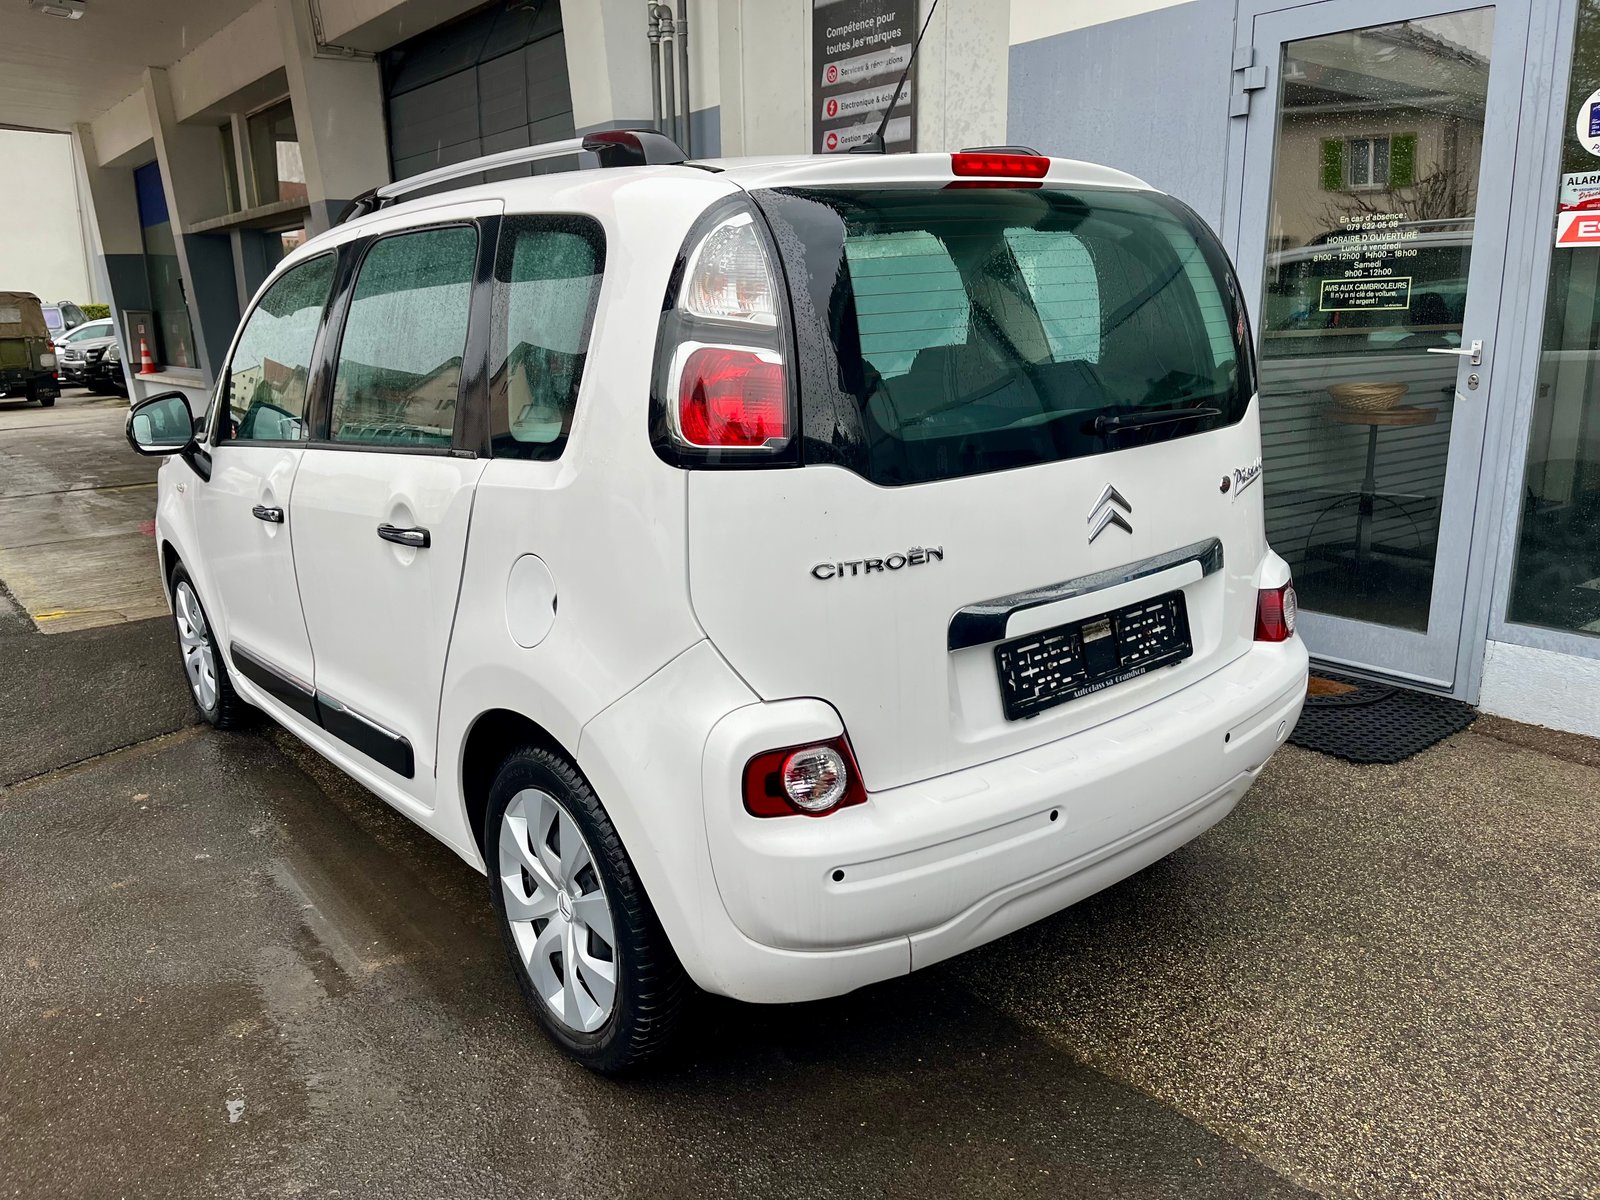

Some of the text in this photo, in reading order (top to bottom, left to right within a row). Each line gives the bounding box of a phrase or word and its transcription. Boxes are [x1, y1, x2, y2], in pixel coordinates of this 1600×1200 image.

[826, 11, 896, 38] Compétence pour
[826, 27, 902, 55] toutes les marques
[841, 63, 864, 76] Services
[865, 62, 870, 71] &
[841, 95, 875, 110] Electronique
[876, 95, 880, 104] &
[840, 133, 862, 144] Gestion
[1340, 216, 1350, 224] En
[1346, 220, 1399, 231] 079 622 05 08
[1327, 231, 1418, 245] HORAIRE D'OUVERTURE
[1341, 244, 1361, 252] Lundi
[1369, 242, 1401, 251] vendredi
[1338, 252, 1360, 260] 12h00
[1365, 251, 1387, 259] 14h00
[1353, 260, 1382, 269] Samedi
[1344, 269, 1362, 278] 9h00
[1369, 268, 1392, 276] 12h00
[1324, 282, 1407, 292] AVIS AUX CAMBRIOLEURS
[1355, 298, 1375, 306] argent
[810, 546, 944, 580] CITROËN
[1073, 667, 1146, 698] Autoclass sa Grandson
